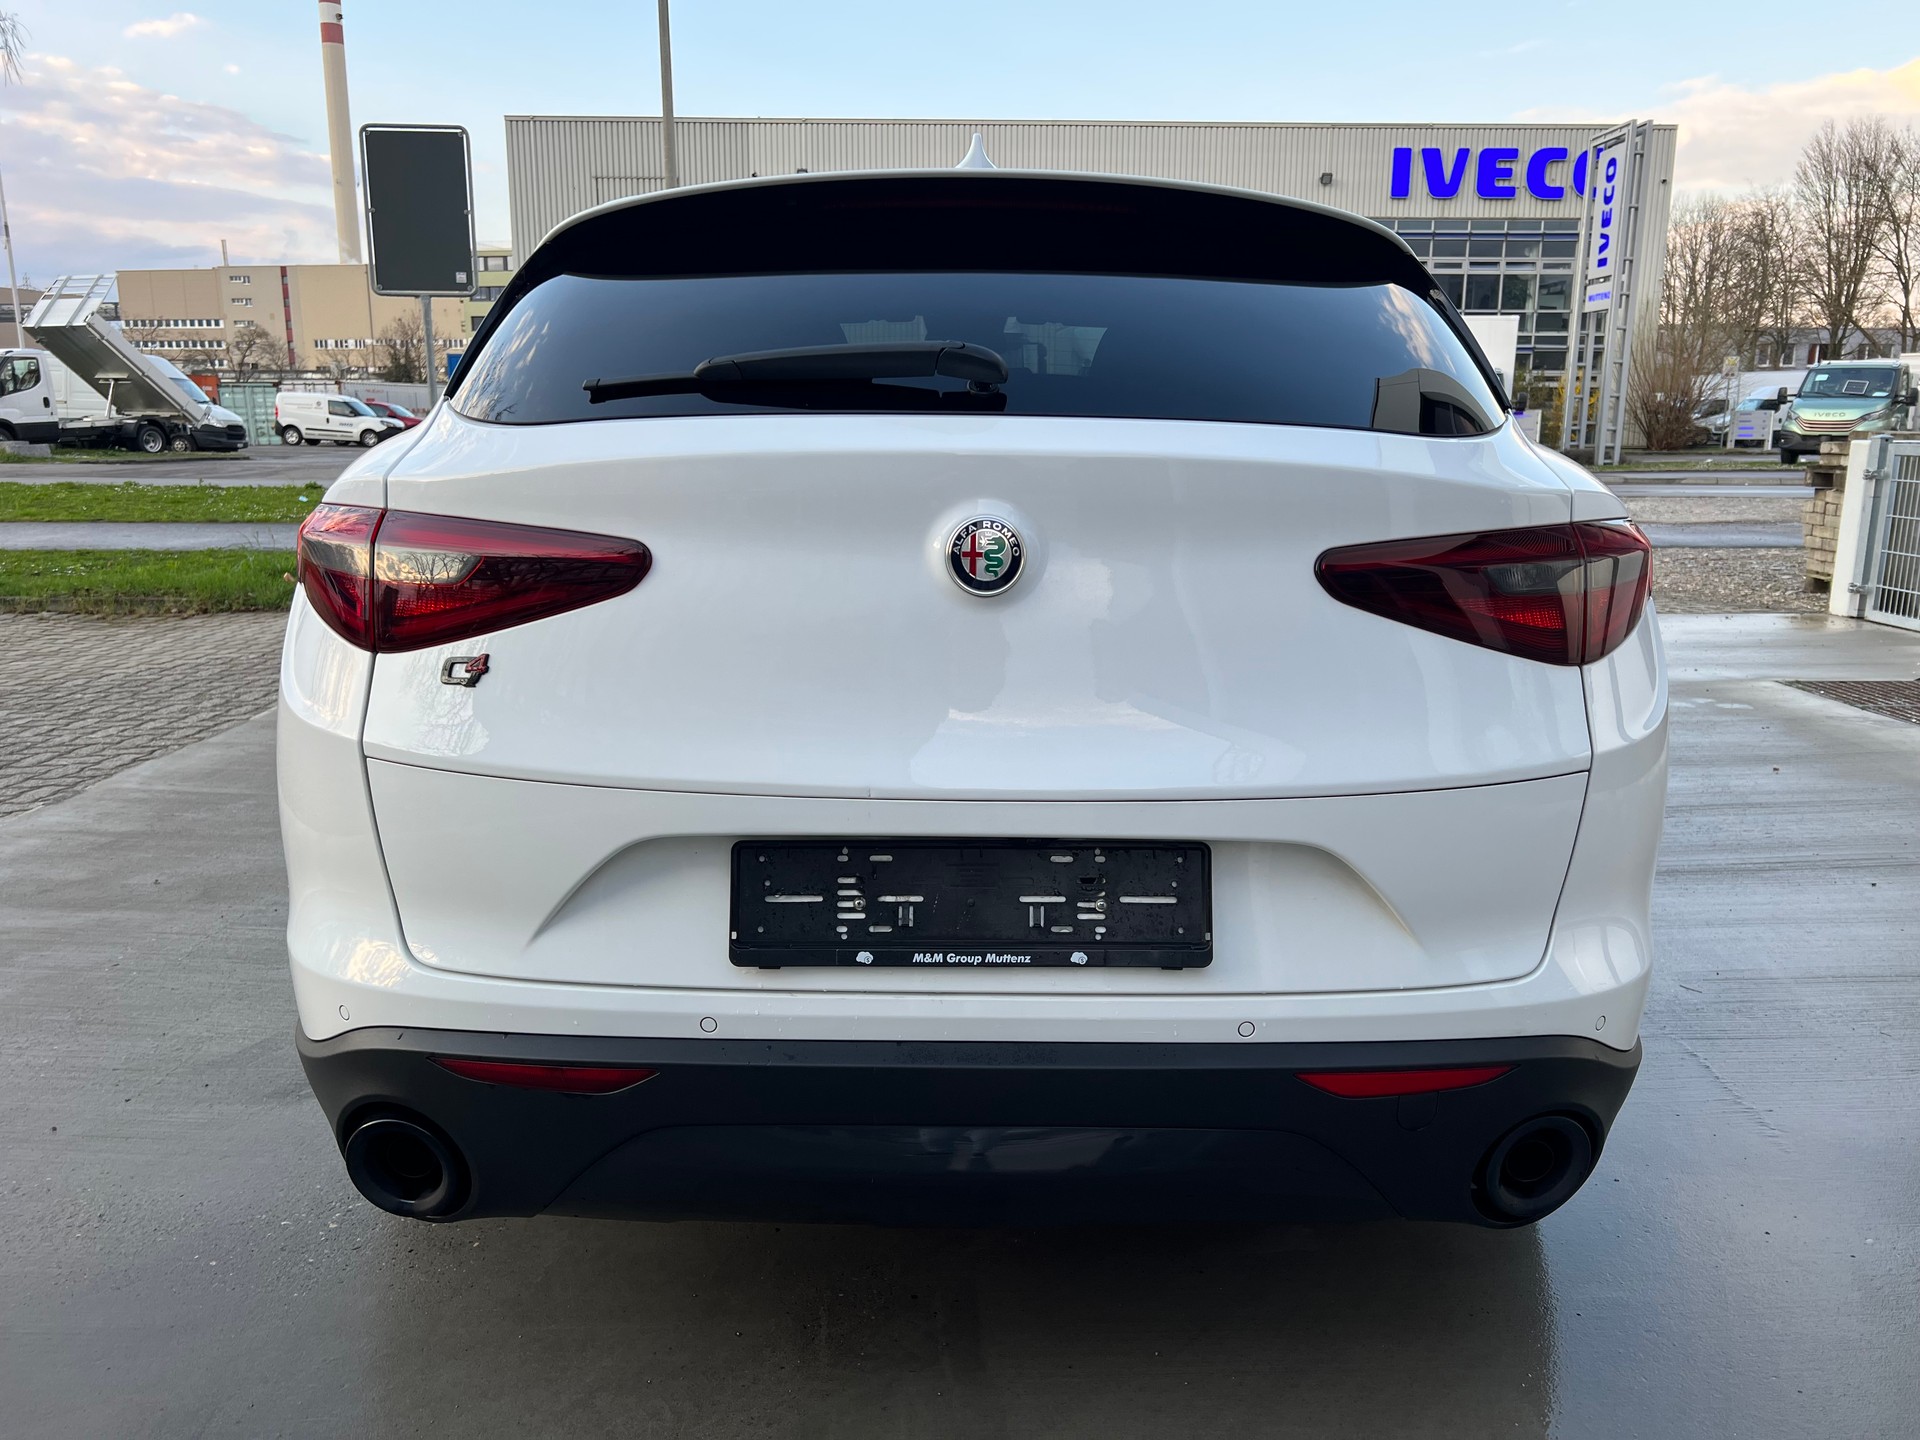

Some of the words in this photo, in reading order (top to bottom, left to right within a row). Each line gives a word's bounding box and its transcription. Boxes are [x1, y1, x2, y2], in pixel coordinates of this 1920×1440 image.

[1597, 157, 1617, 268] IVECO
[953, 524, 977, 555] ALFA
[982, 520, 1020, 556] ROMEO
[912, 953, 943, 963] M&M
[946, 953, 982, 965] Group
[985, 953, 1031, 963] Muttenz
